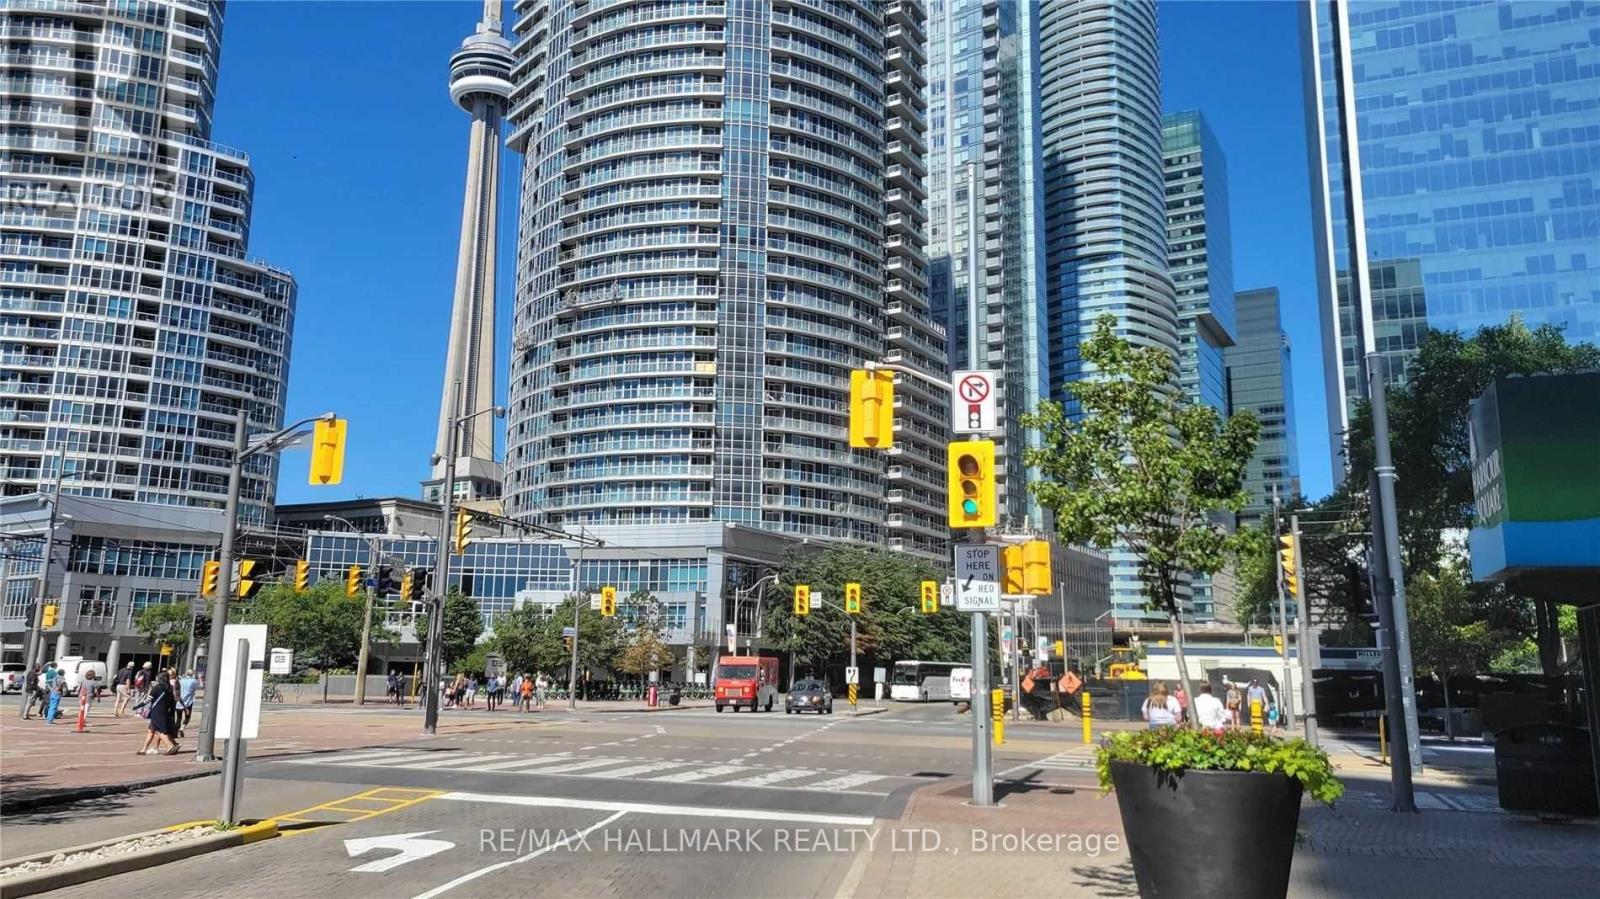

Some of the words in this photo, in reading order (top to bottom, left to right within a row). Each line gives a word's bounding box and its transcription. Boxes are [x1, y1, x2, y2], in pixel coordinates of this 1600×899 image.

[966, 549, 990, 559] STOP
[966, 561, 991, 570] HERE
[983, 573, 994, 581] ON
[978, 584, 994, 593] RED
[964, 597, 994, 605] SIGNAL
